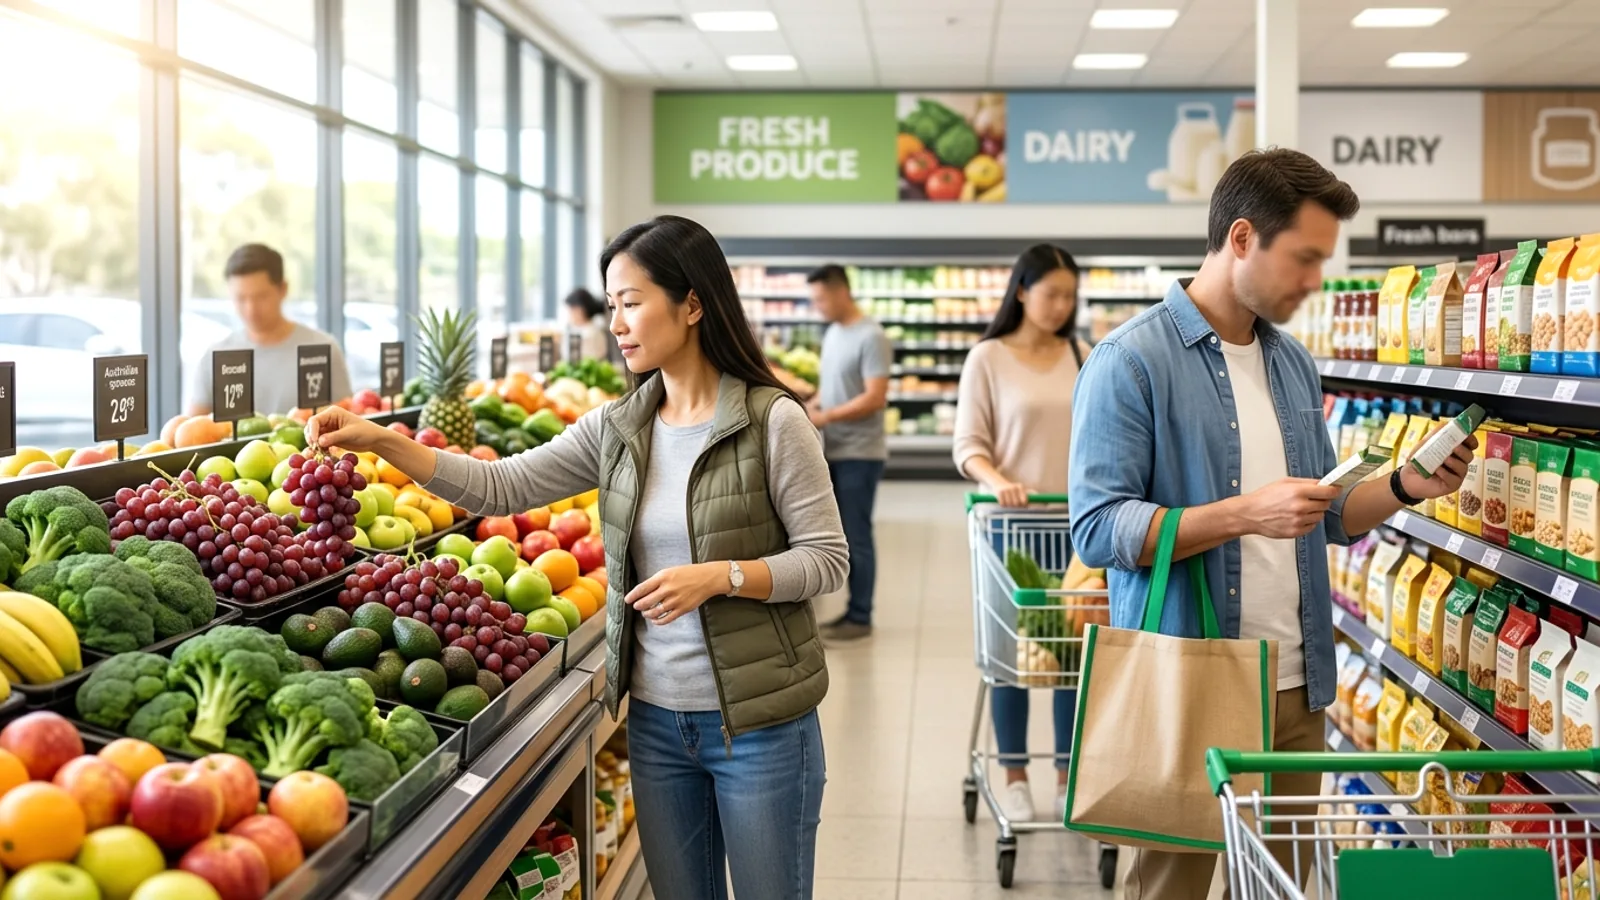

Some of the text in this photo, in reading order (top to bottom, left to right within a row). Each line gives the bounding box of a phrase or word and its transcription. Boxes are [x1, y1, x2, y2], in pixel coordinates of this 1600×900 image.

[719, 116, 829, 146] FRESH
[1024, 130, 1136, 162] DAIRY
[690, 150, 859, 180] PRODUCE
[1333, 136, 1441, 165] DAIRY
